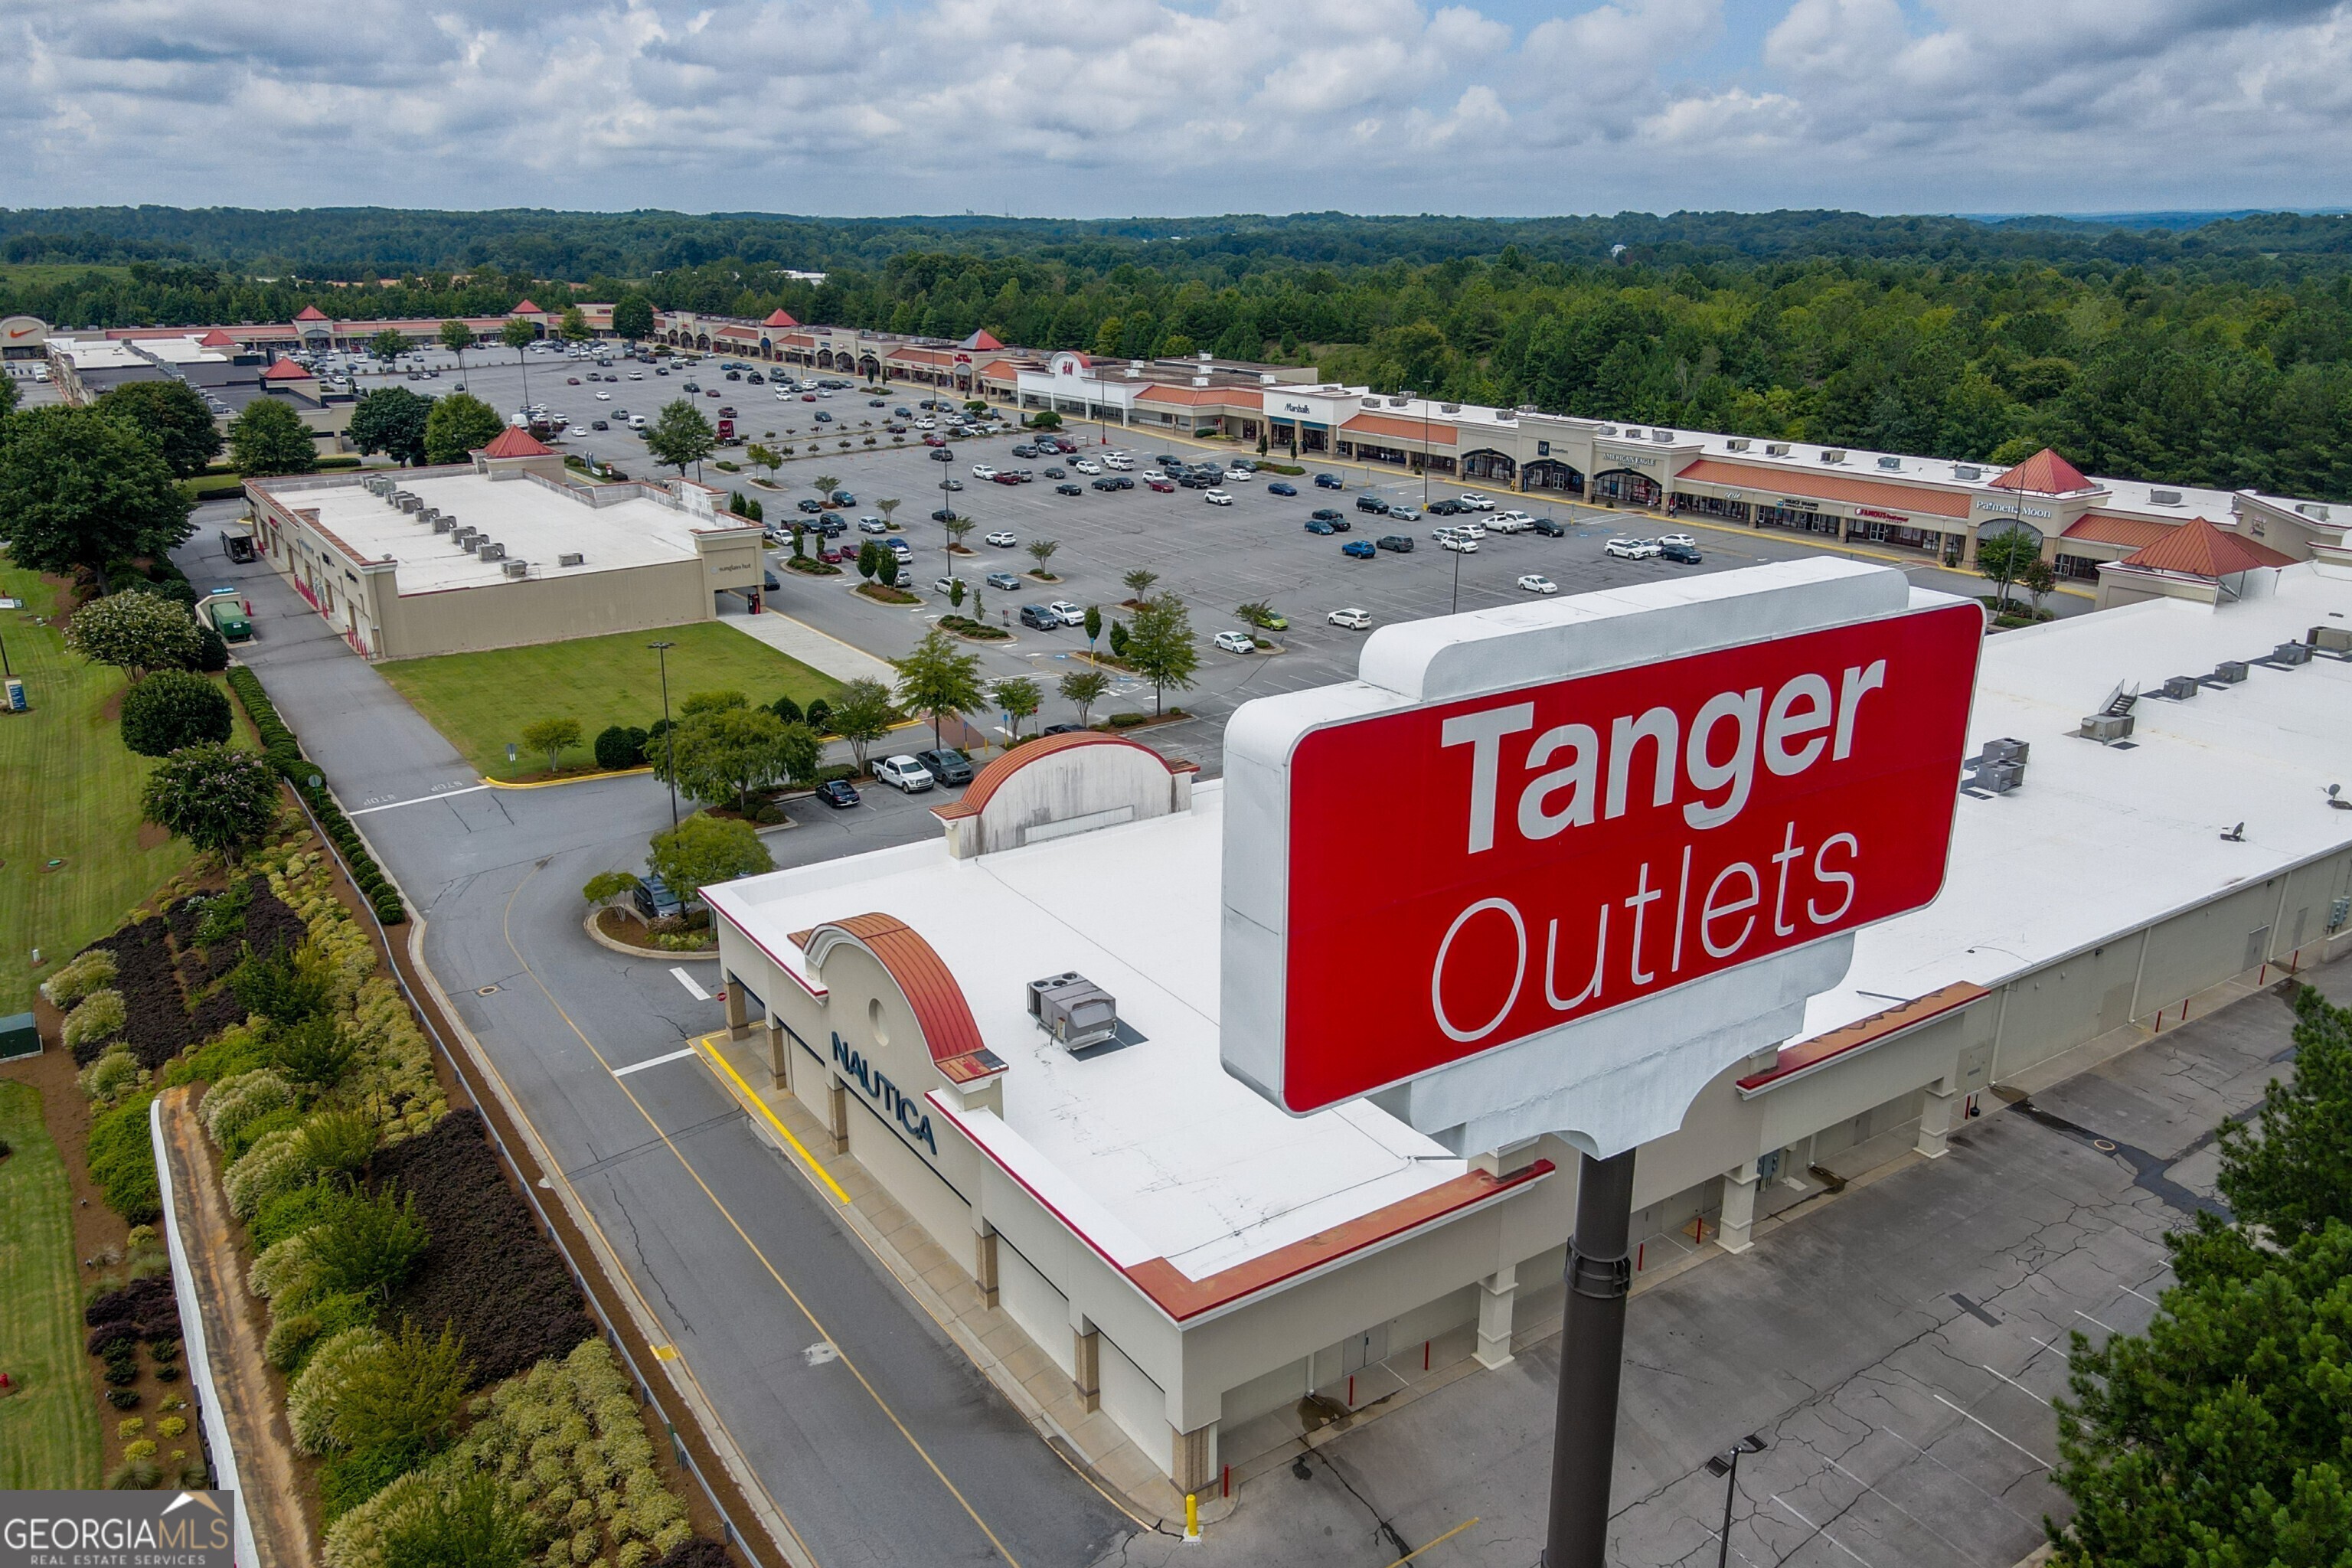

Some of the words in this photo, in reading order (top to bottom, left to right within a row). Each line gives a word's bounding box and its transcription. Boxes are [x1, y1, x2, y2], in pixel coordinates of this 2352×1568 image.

[1284, 403, 1310, 414] Marshalls
[1603, 452, 1635, 463] AMERICAN
[1635, 457, 1655, 466] EAGLE
[1860, 509, 1886, 518] FAMOUS
[1976, 500, 2019, 514] Palmetto
[2022, 507, 2051, 518] Moon
[1441, 659, 1886, 854] Tanger
[430, 780, 462, 792] STOP
[363, 794, 397, 806] STOP
[1432, 822, 1858, 1042] Outlets
[831, 1031, 937, 1155] NAUTICA
